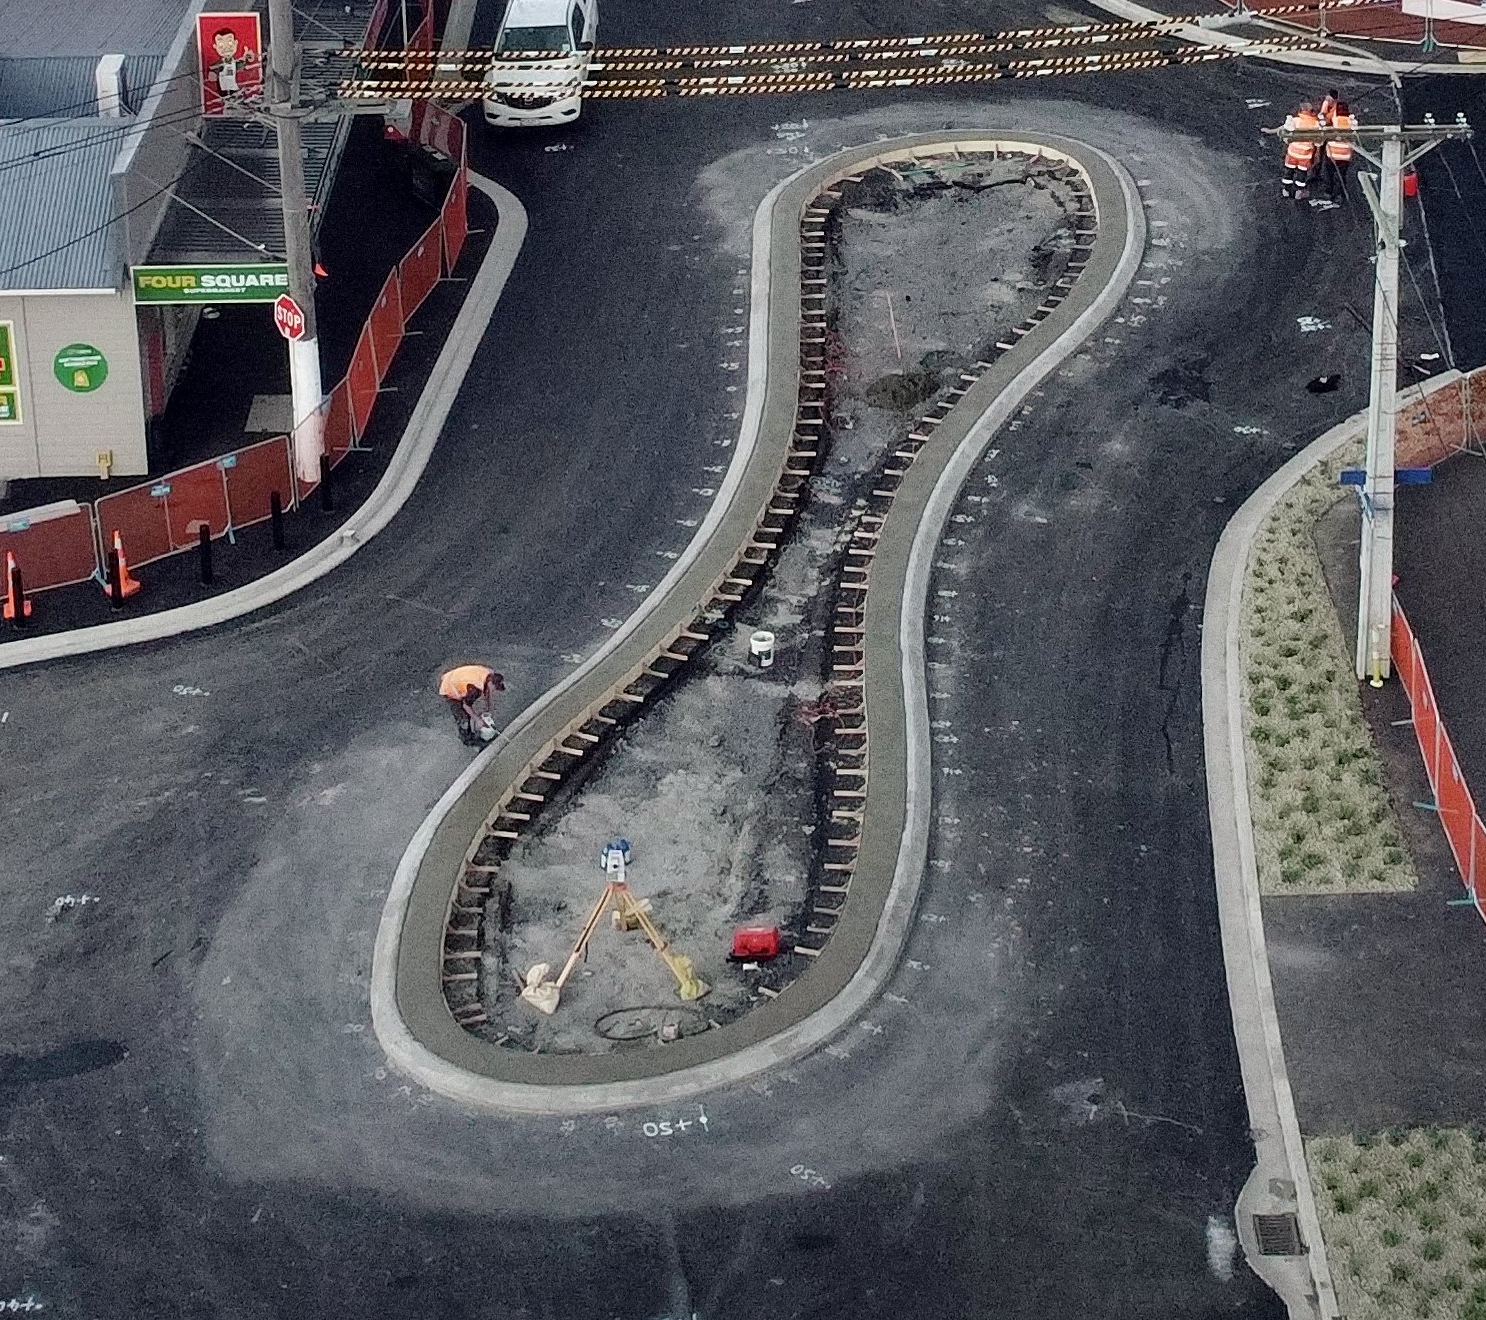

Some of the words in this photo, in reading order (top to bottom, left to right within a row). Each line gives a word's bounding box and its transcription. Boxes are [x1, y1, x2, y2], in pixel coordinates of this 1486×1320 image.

[138, 275, 197, 288] FOUR
[200, 274, 289, 287] SQUARE
[277, 304, 302, 329] STOP
